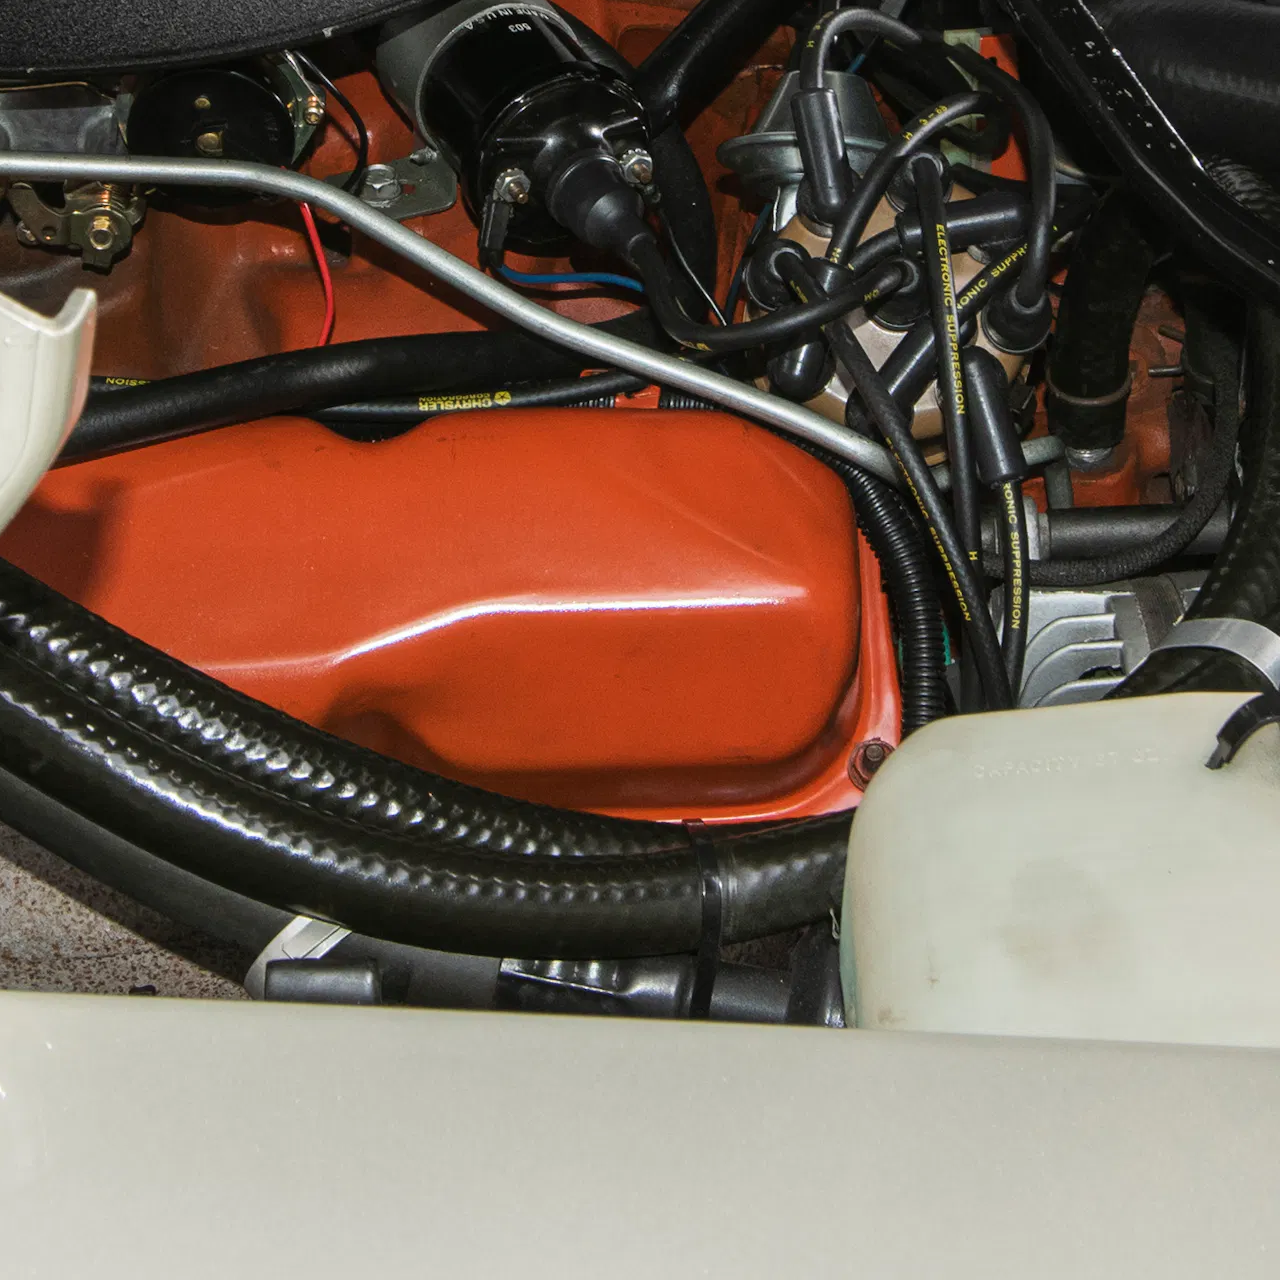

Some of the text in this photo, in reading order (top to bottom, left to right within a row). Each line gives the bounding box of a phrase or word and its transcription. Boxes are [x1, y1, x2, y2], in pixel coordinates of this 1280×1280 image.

[498, 8, 512, 16] IN
[934, 223, 966, 416] ELECTRONIC SUPPRESSION
[418, 392, 490, 401] CORPORATION
[418, 398, 492, 410] CHRYSLER
[928, 526, 972, 622] SUPPRESSION
[1010, 531, 1022, 630] SUPPRESSION
[972, 754, 1080, 780] CAPACITY
